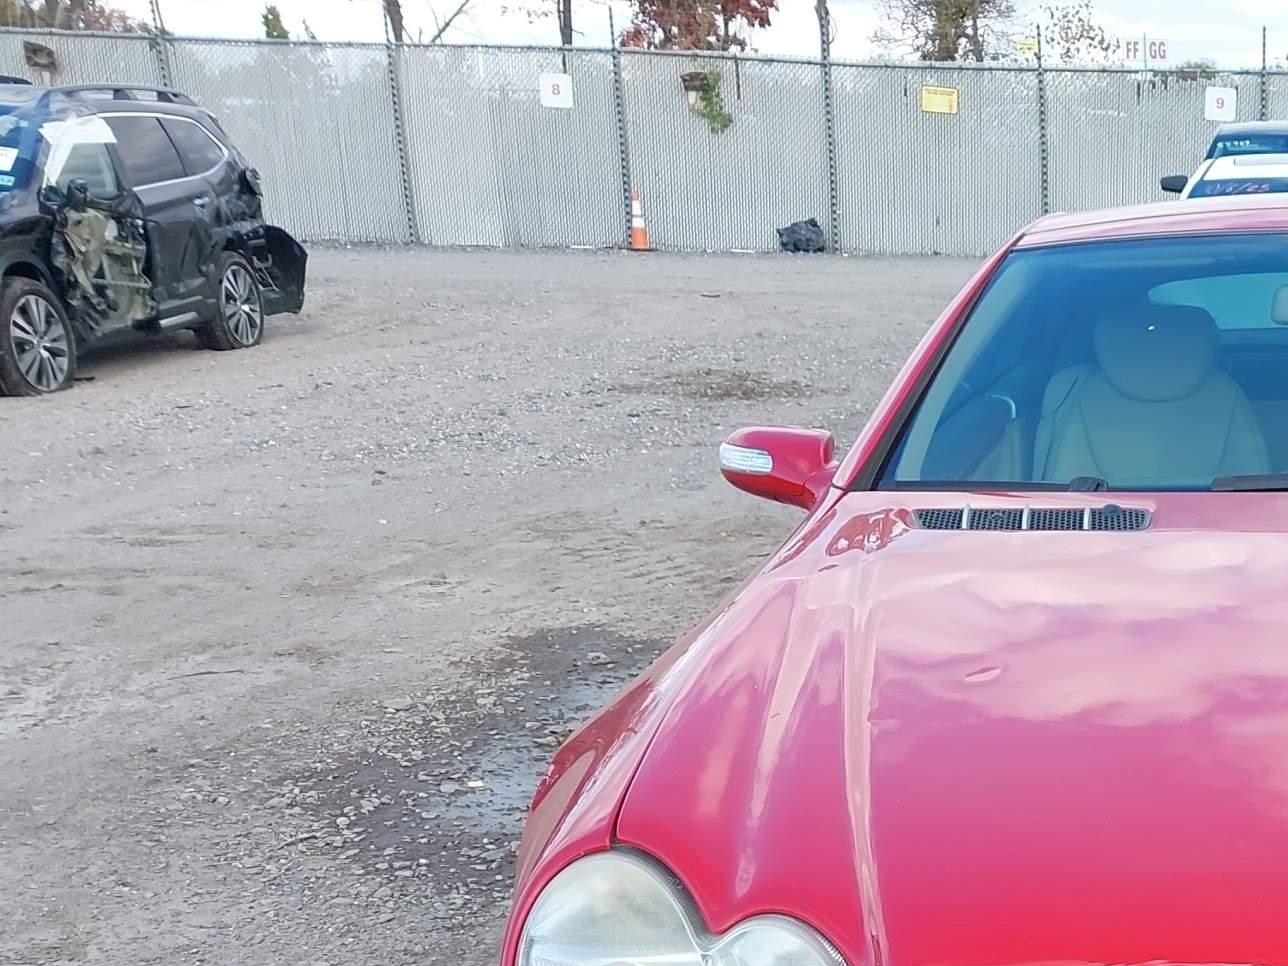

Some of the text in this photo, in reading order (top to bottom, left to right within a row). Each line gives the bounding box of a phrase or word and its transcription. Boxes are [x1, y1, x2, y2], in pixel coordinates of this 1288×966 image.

[1125, 41, 1140, 60] FF
[1149, 41, 1167, 60] GG
[551, 83, 561, 96] 8
[1215, 97, 1225, 110] 9
